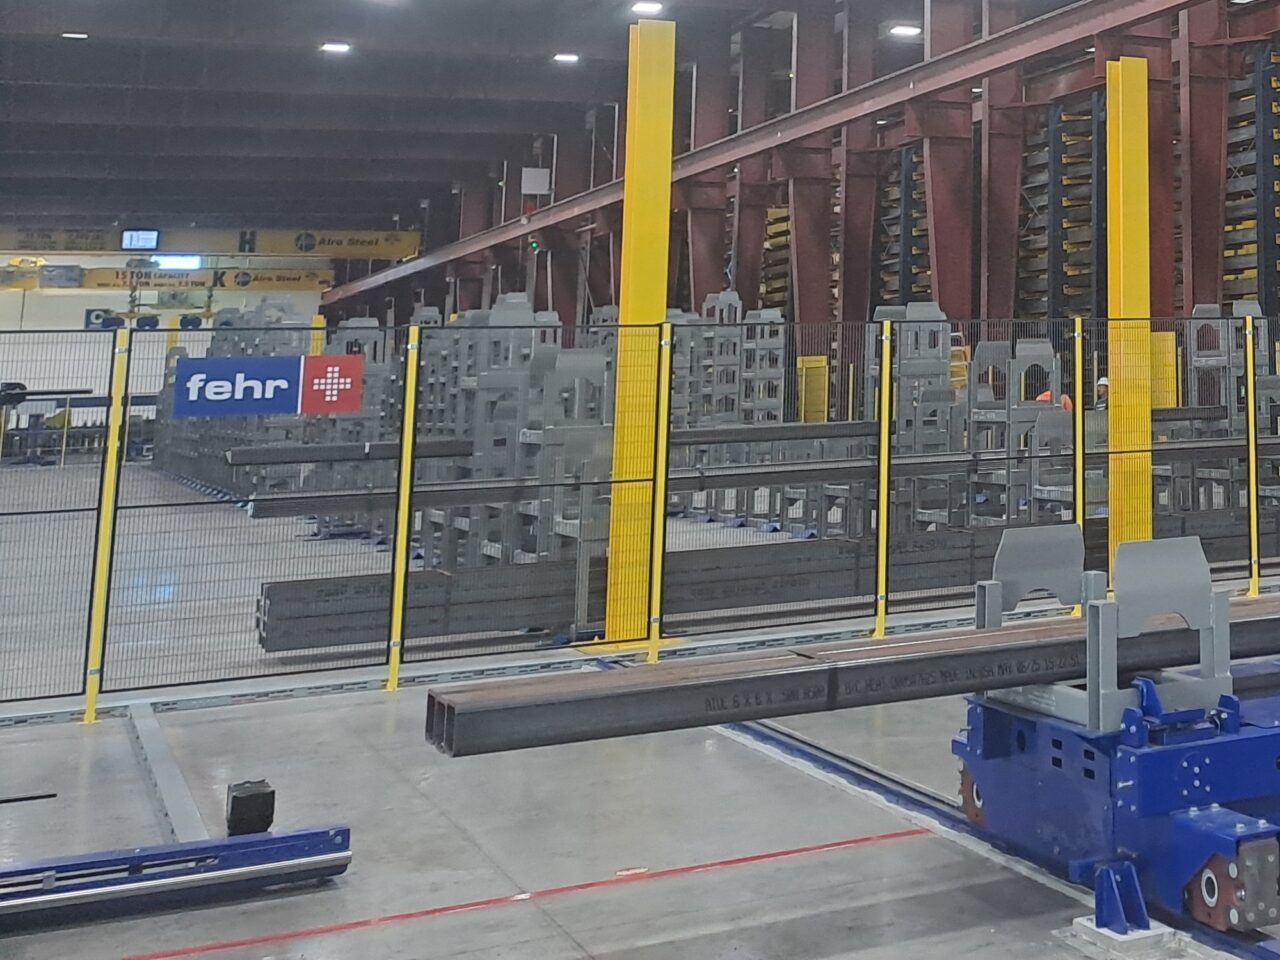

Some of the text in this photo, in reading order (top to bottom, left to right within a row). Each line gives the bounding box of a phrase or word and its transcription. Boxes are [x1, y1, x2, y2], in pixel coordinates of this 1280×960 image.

[238, 231, 256, 252] H
[318, 238, 379, 246] Alro Steel
[130, 270, 151, 280] TON
[212, 270, 226, 288] K
[252, 273, 301, 282] Alro Steel
[186, 373, 288, 401] fehr
